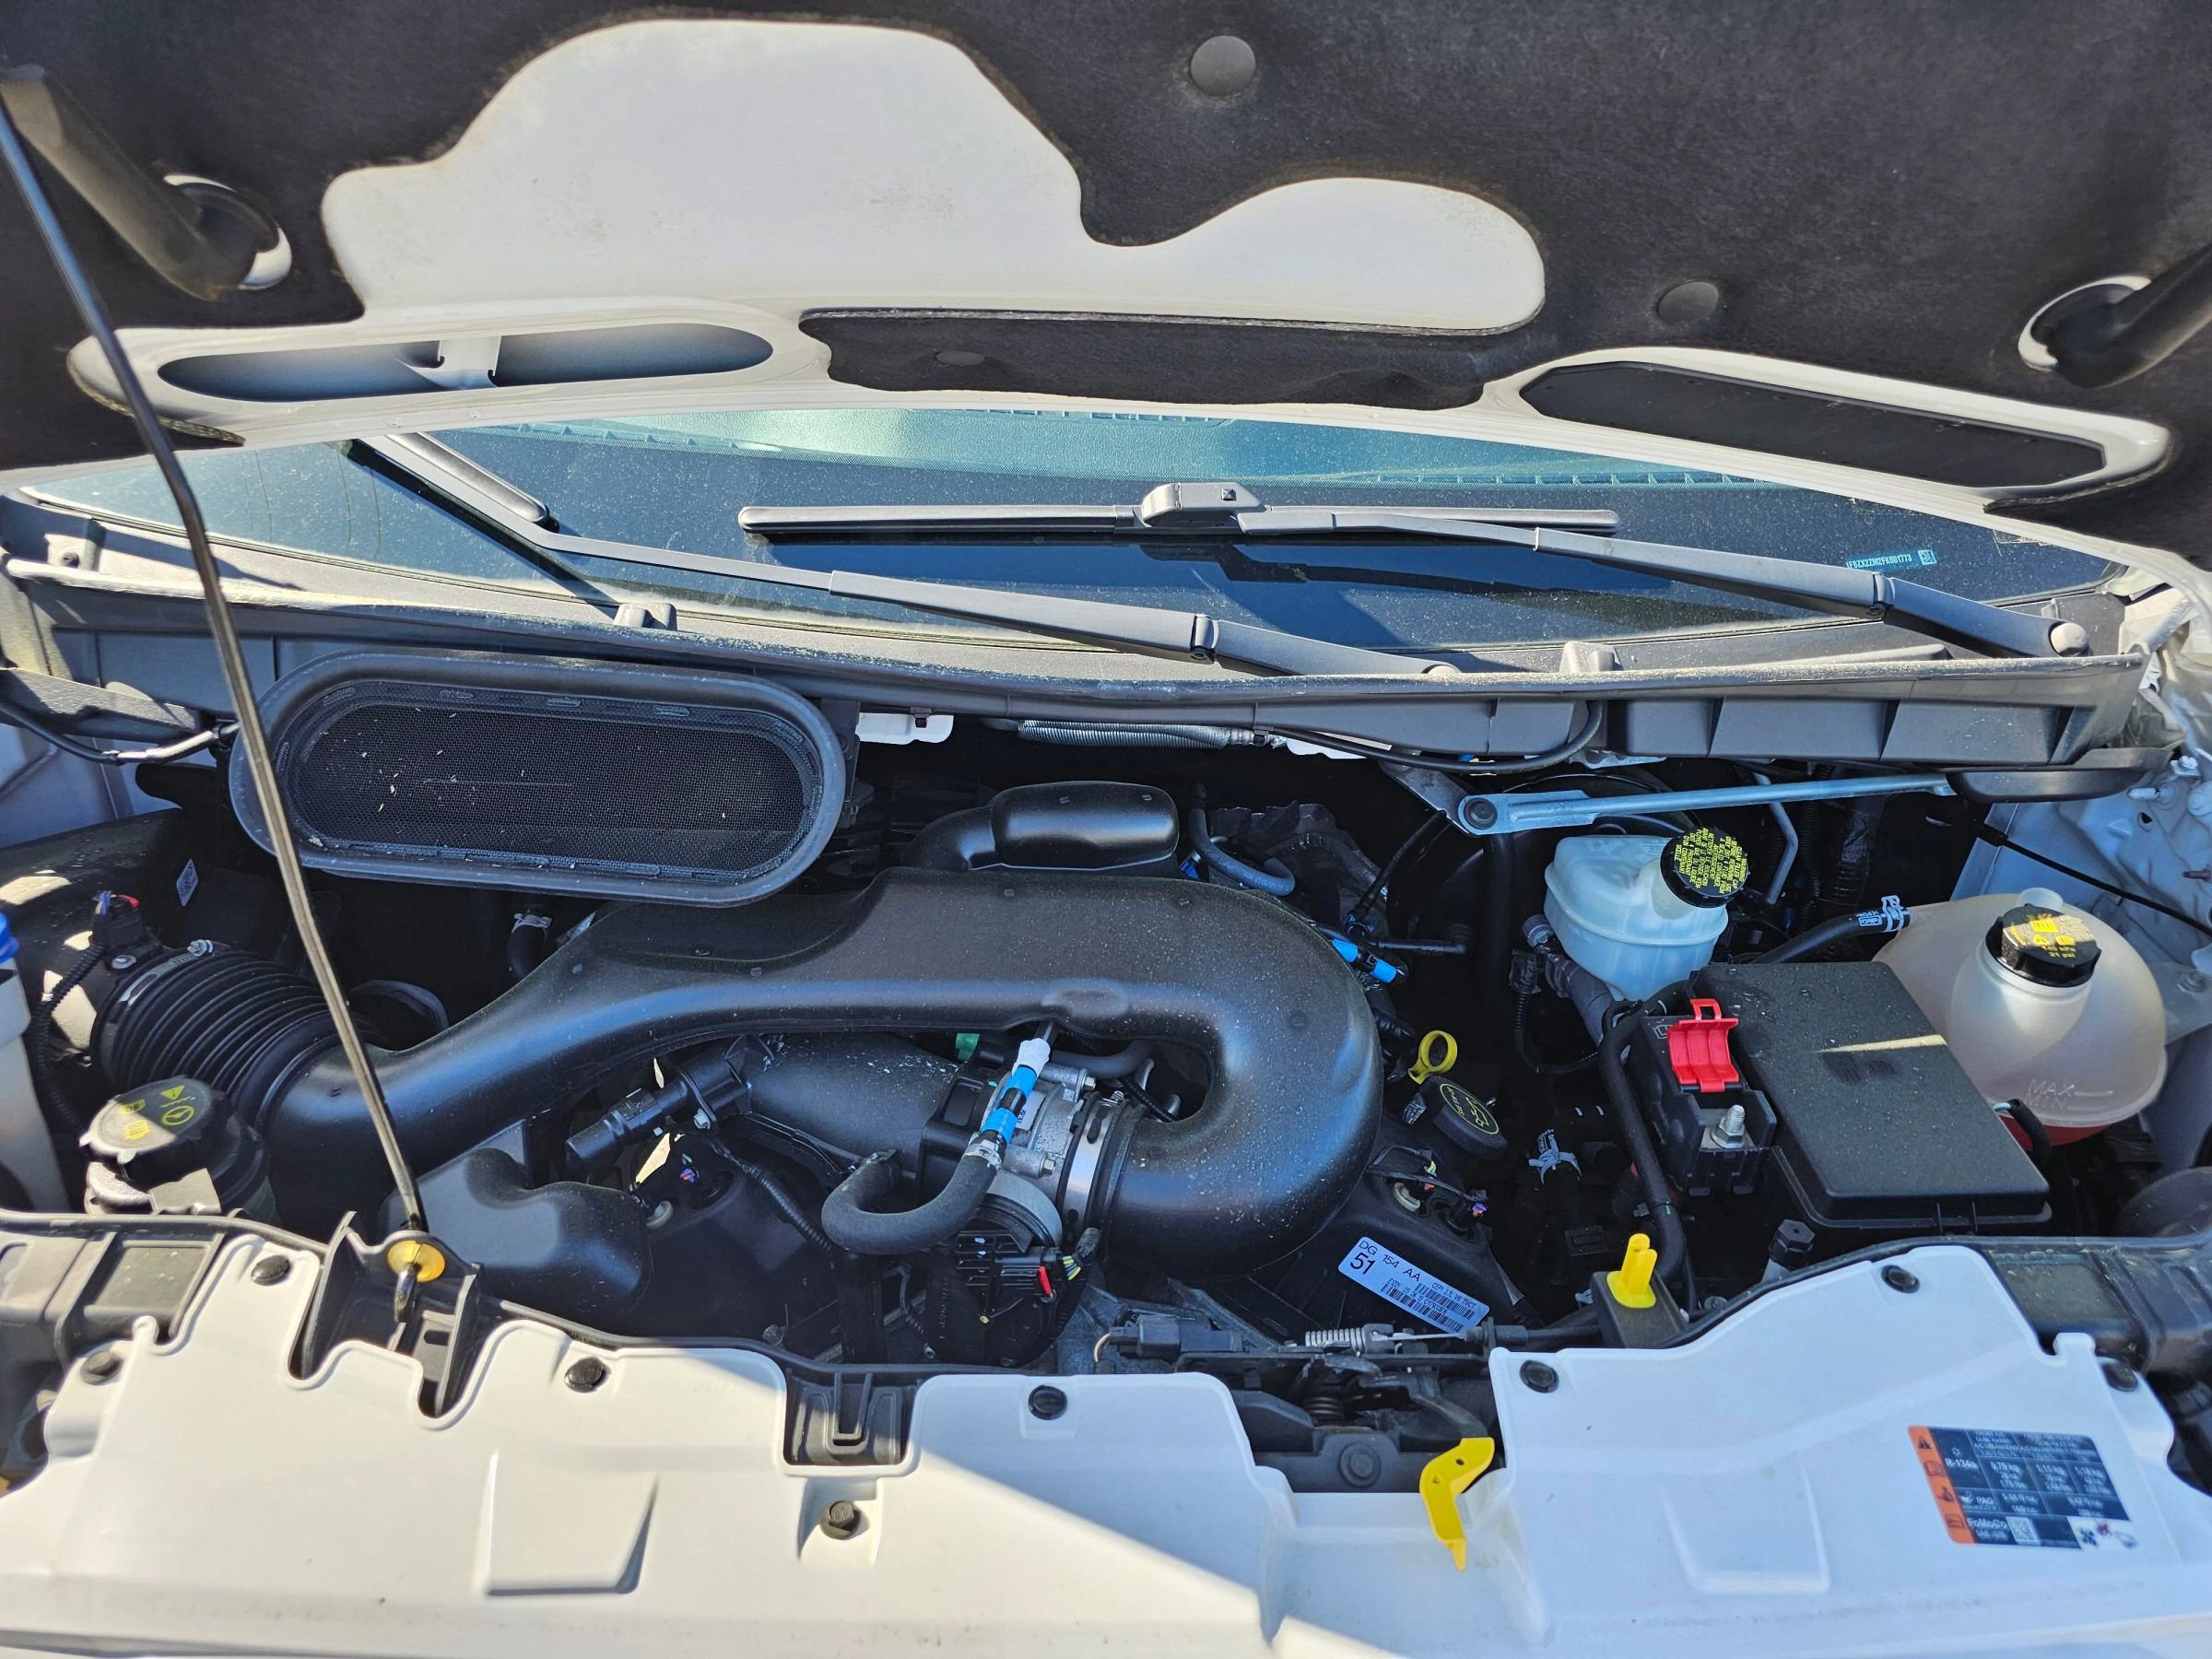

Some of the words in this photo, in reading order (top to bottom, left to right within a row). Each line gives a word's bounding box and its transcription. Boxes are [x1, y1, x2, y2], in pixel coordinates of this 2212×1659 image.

[2028, 1078, 2075, 1097] MAX
[1350, 1253, 1376, 1275] 51
[1359, 1240, 1377, 1254] DG
[1382, 1254, 1400, 1268] 154
[1403, 1268, 1421, 1282] AA
[1946, 1458, 1979, 1471] R-134a
[1968, 1517, 2007, 1530] FoMoCo
